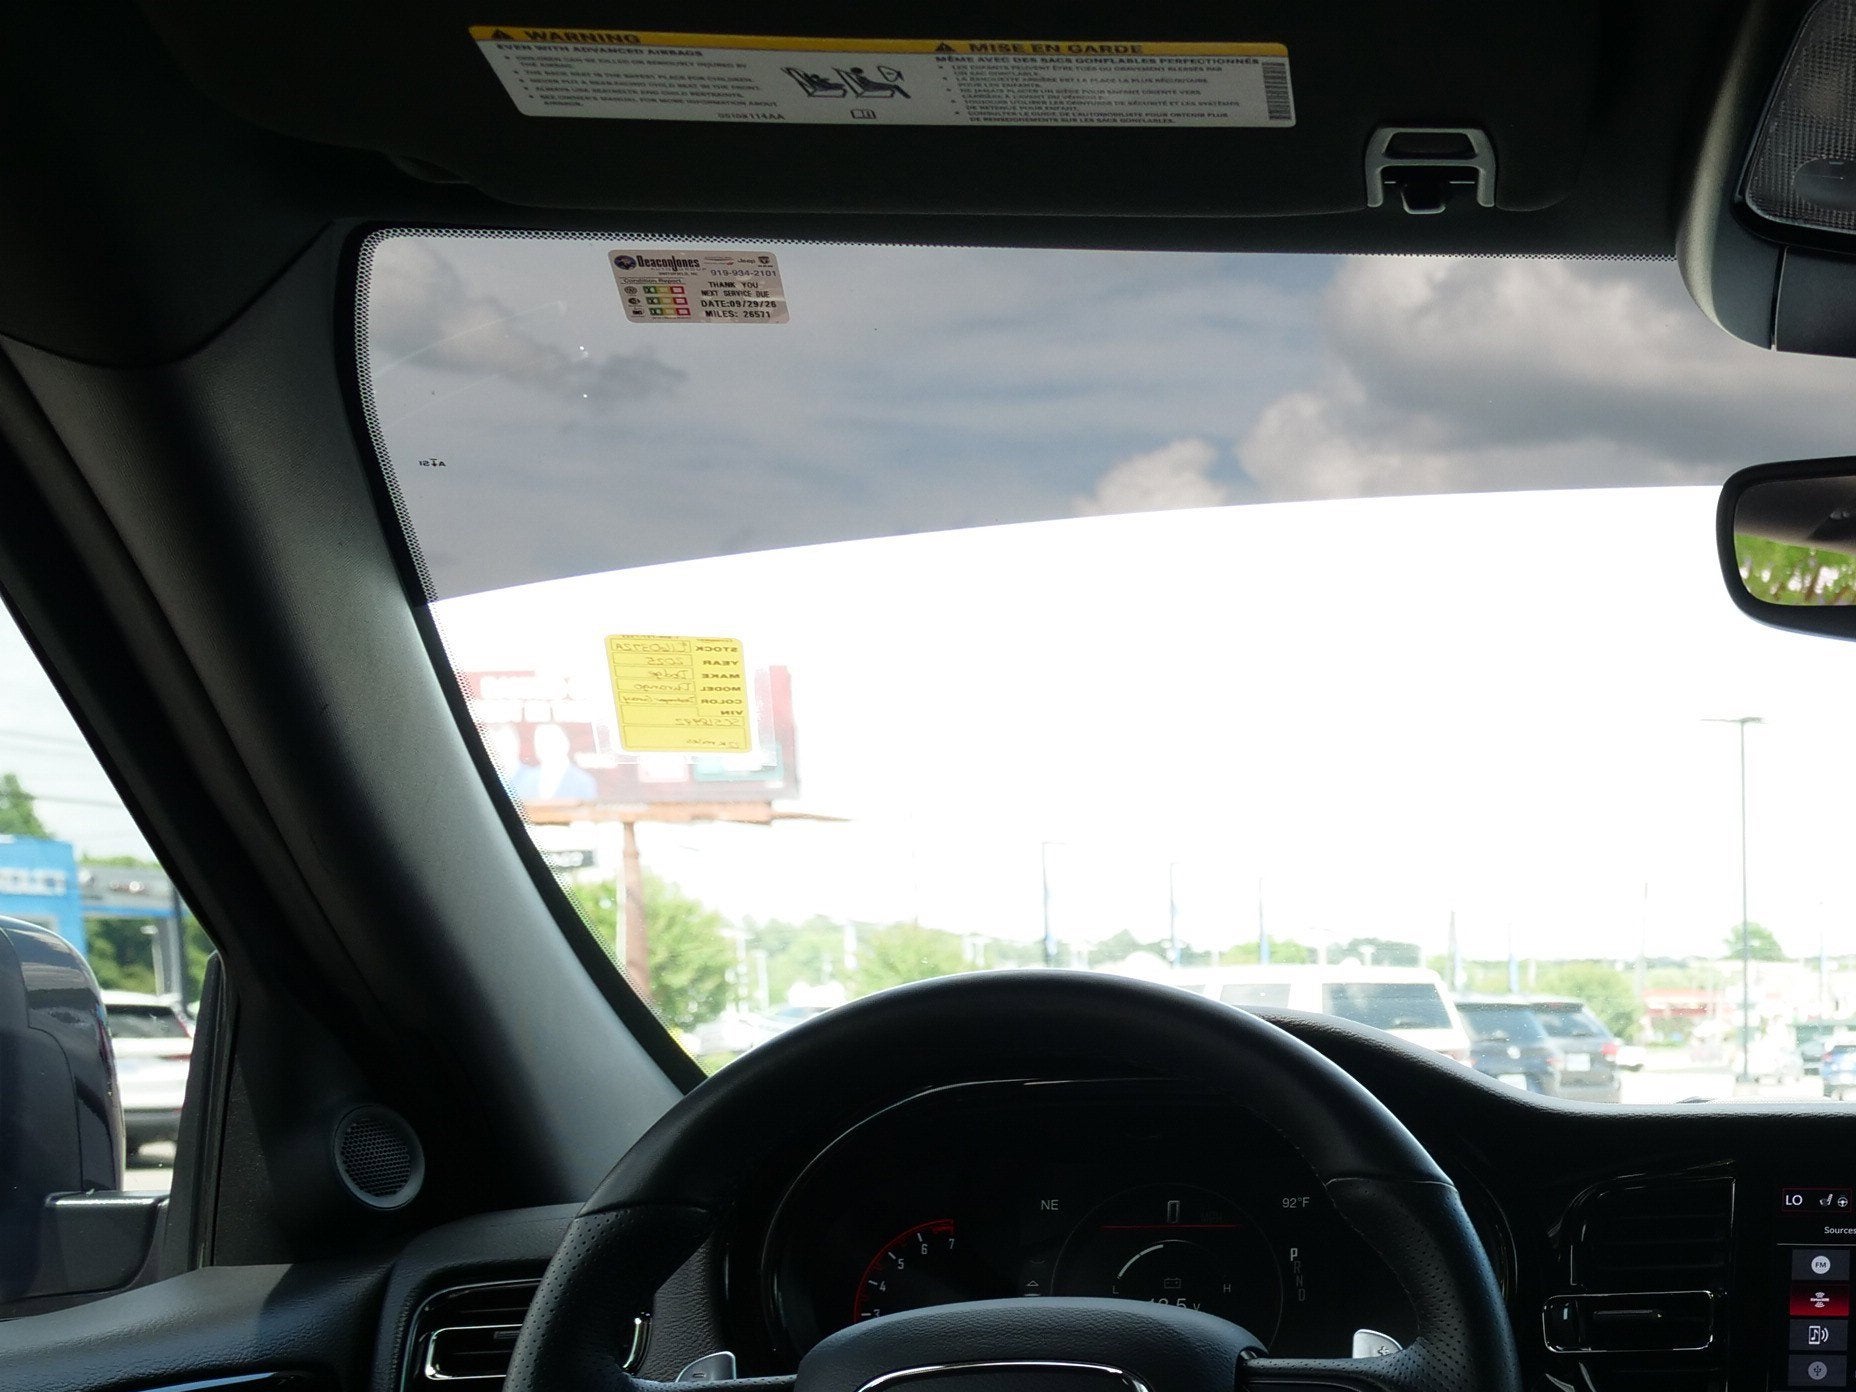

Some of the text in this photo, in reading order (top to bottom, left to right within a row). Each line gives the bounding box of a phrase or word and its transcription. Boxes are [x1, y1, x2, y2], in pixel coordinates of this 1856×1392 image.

[525, 31, 640, 44] WARNING
[536, 45, 571, 53] WITH
[573, 46, 643, 56] ADVANCED
[648, 48, 703, 57] AIRBAGS
[969, 44, 1143, 55] MISE EN GARDE
[936, 55, 975, 63] MÊME
[1159, 57, 1259, 65] PERFECTIONNÉS
[711, 269, 777, 277] 919-934-2101
[708, 281, 736, 289] THANK
[723, 290, 752, 298] SERVICE
[705, 310, 738, 318] MILES:
[1040, 1200, 1059, 1211] NE
[1282, 1197, 1311, 1208] 92°F
[1785, 1195, 1803, 1206] LO
[921, 1244, 928, 1255] 6
[948, 1239, 955, 1250] 7
[1290, 1248, 1298, 1262] P
[897, 1258, 905, 1270] 5
[1293, 1261, 1301, 1273] R
[1814, 1261, 1827, 1269] FM
[879, 1282, 887, 1292] 4
[1113, 1285, 1120, 1295] L
[1223, 1283, 1232, 1293] H
